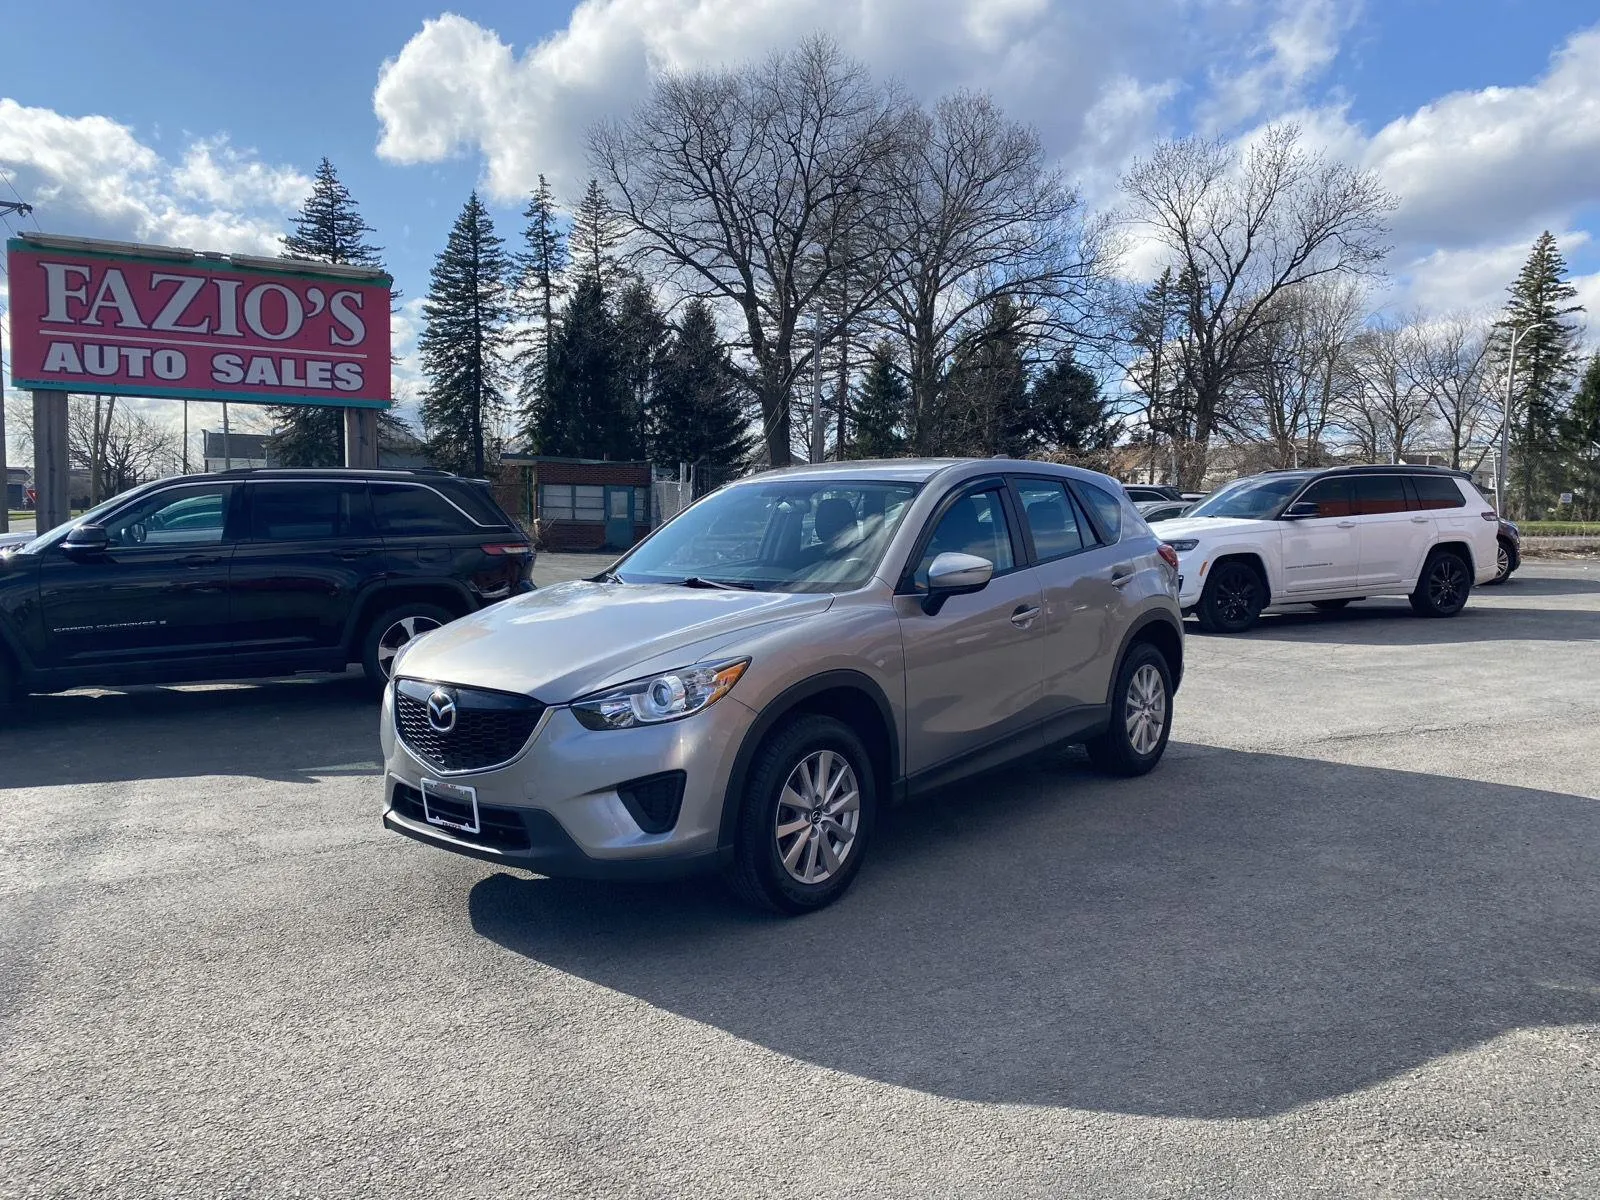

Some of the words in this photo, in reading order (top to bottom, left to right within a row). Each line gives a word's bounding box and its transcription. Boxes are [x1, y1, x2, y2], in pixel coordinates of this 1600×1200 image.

[38, 261, 367, 347] FAZIO'S
[43, 342, 187, 380] AUTO
[211, 353, 365, 392] SALES
